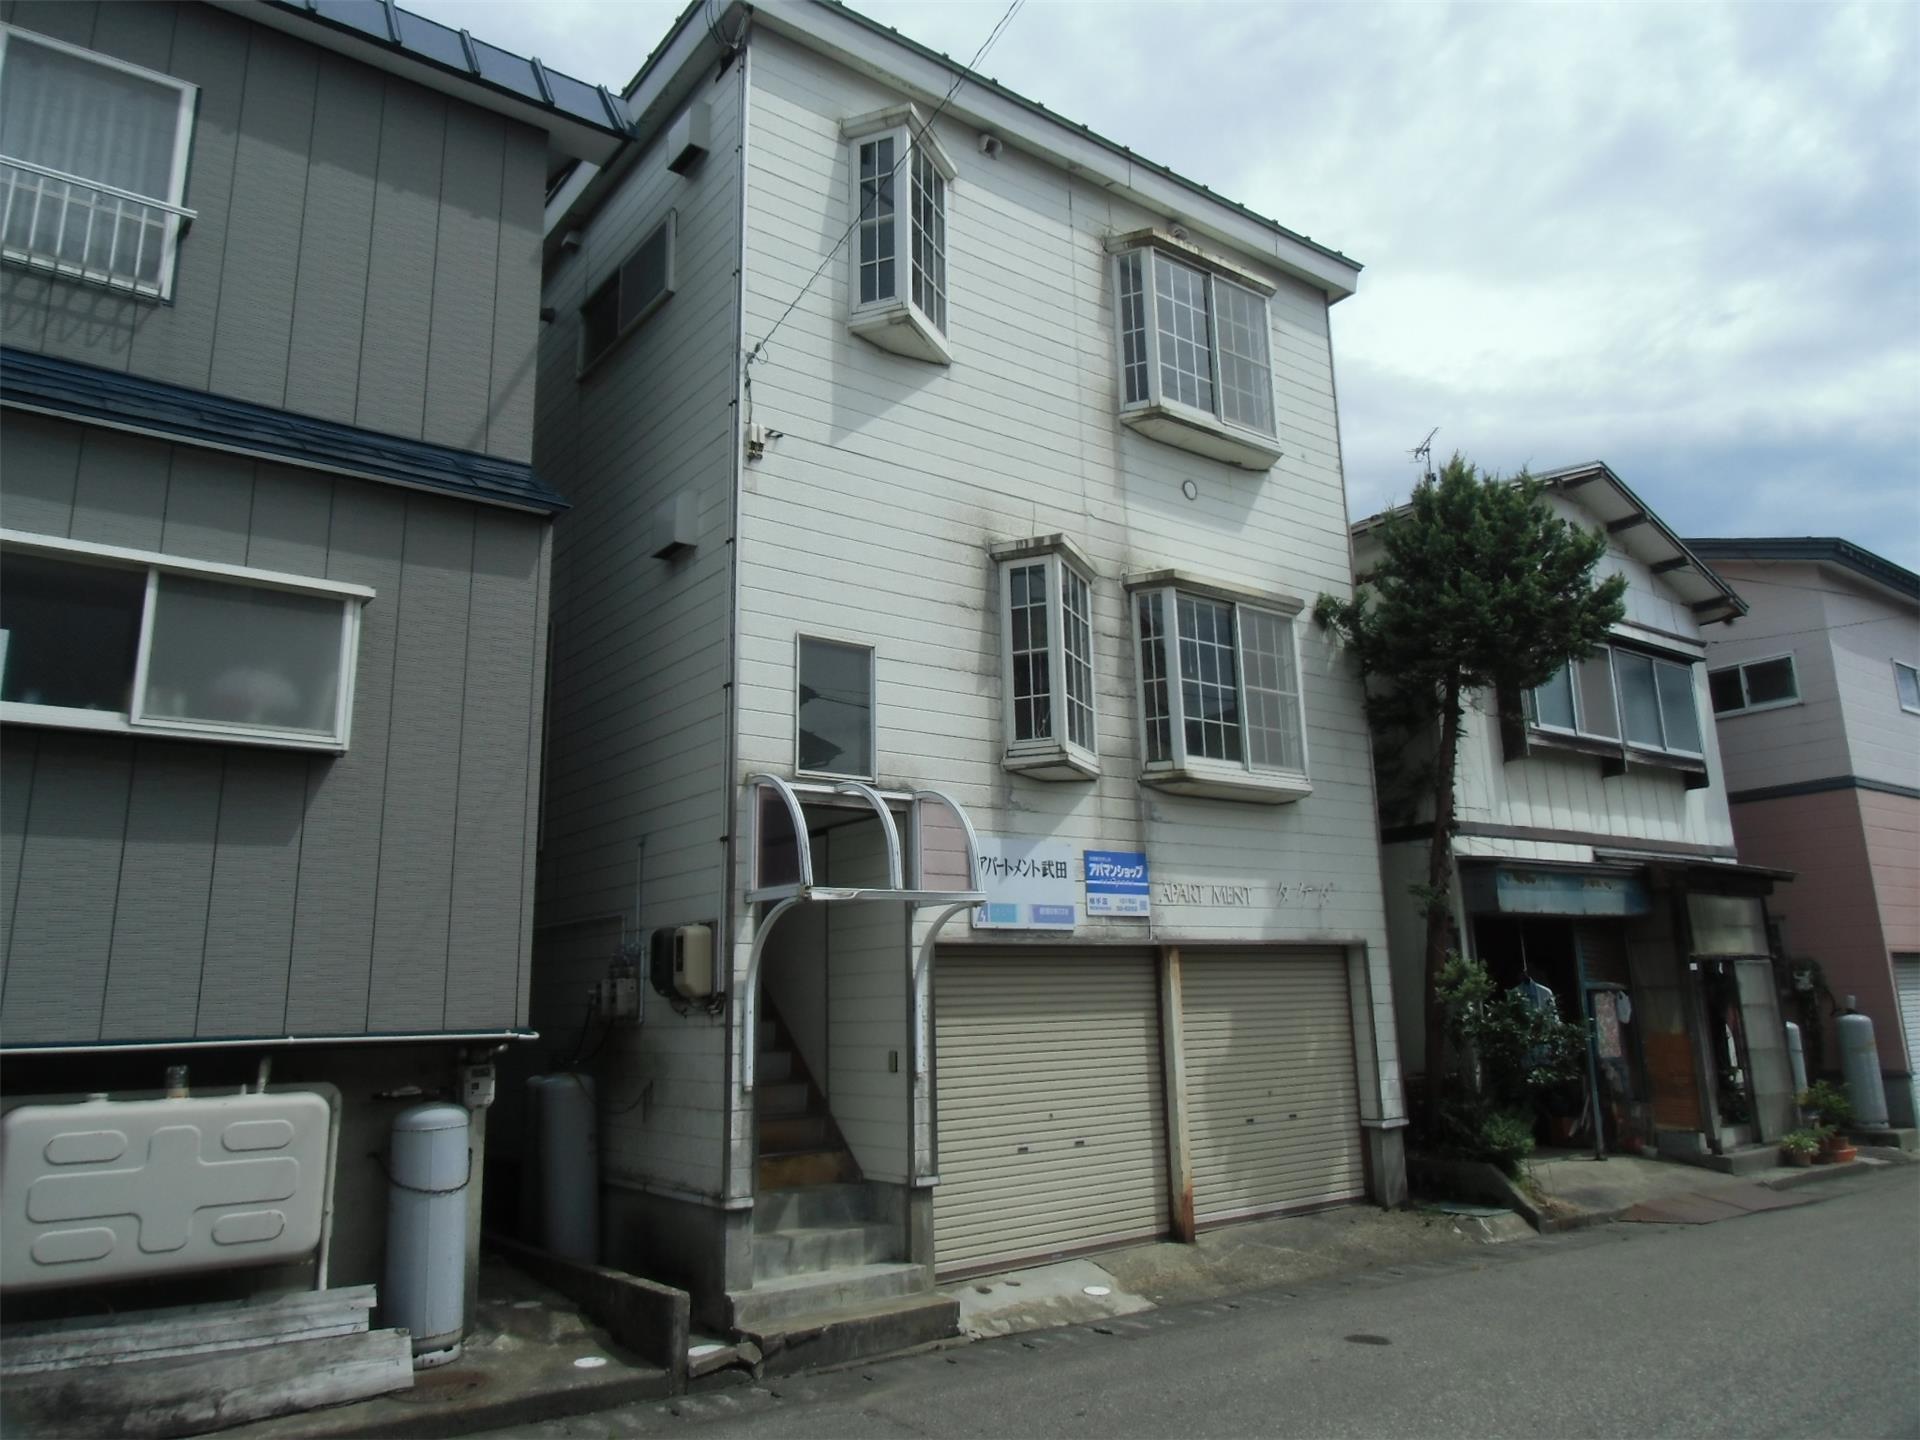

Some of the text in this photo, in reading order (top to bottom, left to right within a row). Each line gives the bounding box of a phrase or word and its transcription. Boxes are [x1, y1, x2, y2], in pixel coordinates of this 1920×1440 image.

[980, 856, 1067, 879] アパートメント武田
[1089, 863, 1144, 879] アパマンショップ
[1159, 881, 1203, 904] APART
[1211, 884, 1252, 906] MENT
